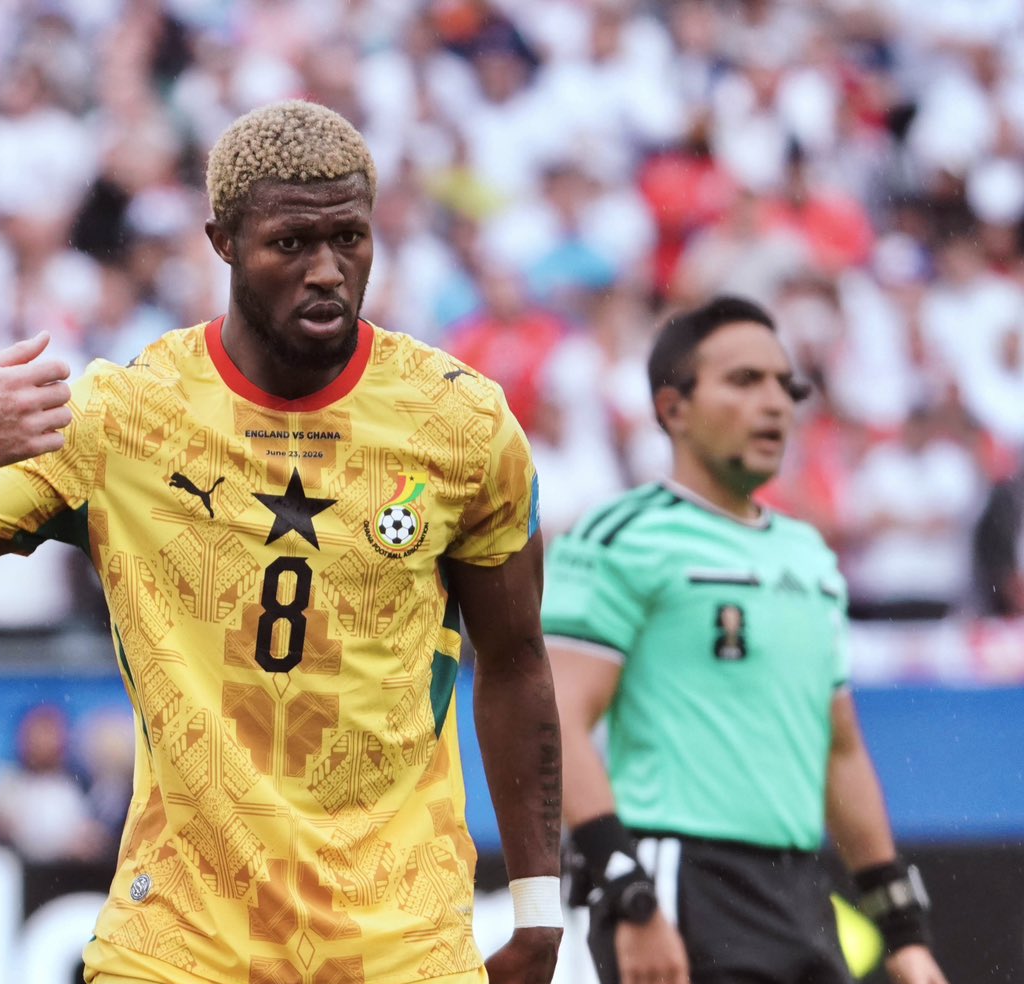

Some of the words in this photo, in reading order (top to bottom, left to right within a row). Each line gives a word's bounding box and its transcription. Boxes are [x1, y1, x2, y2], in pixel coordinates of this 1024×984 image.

[245, 430, 290, 439] ENGLAND
[292, 431, 304, 439] VS
[307, 431, 341, 440] GHANA
[289, 450, 301, 458] 23,
[303, 450, 323, 458] 2026
[255, 556, 313, 673] 8
